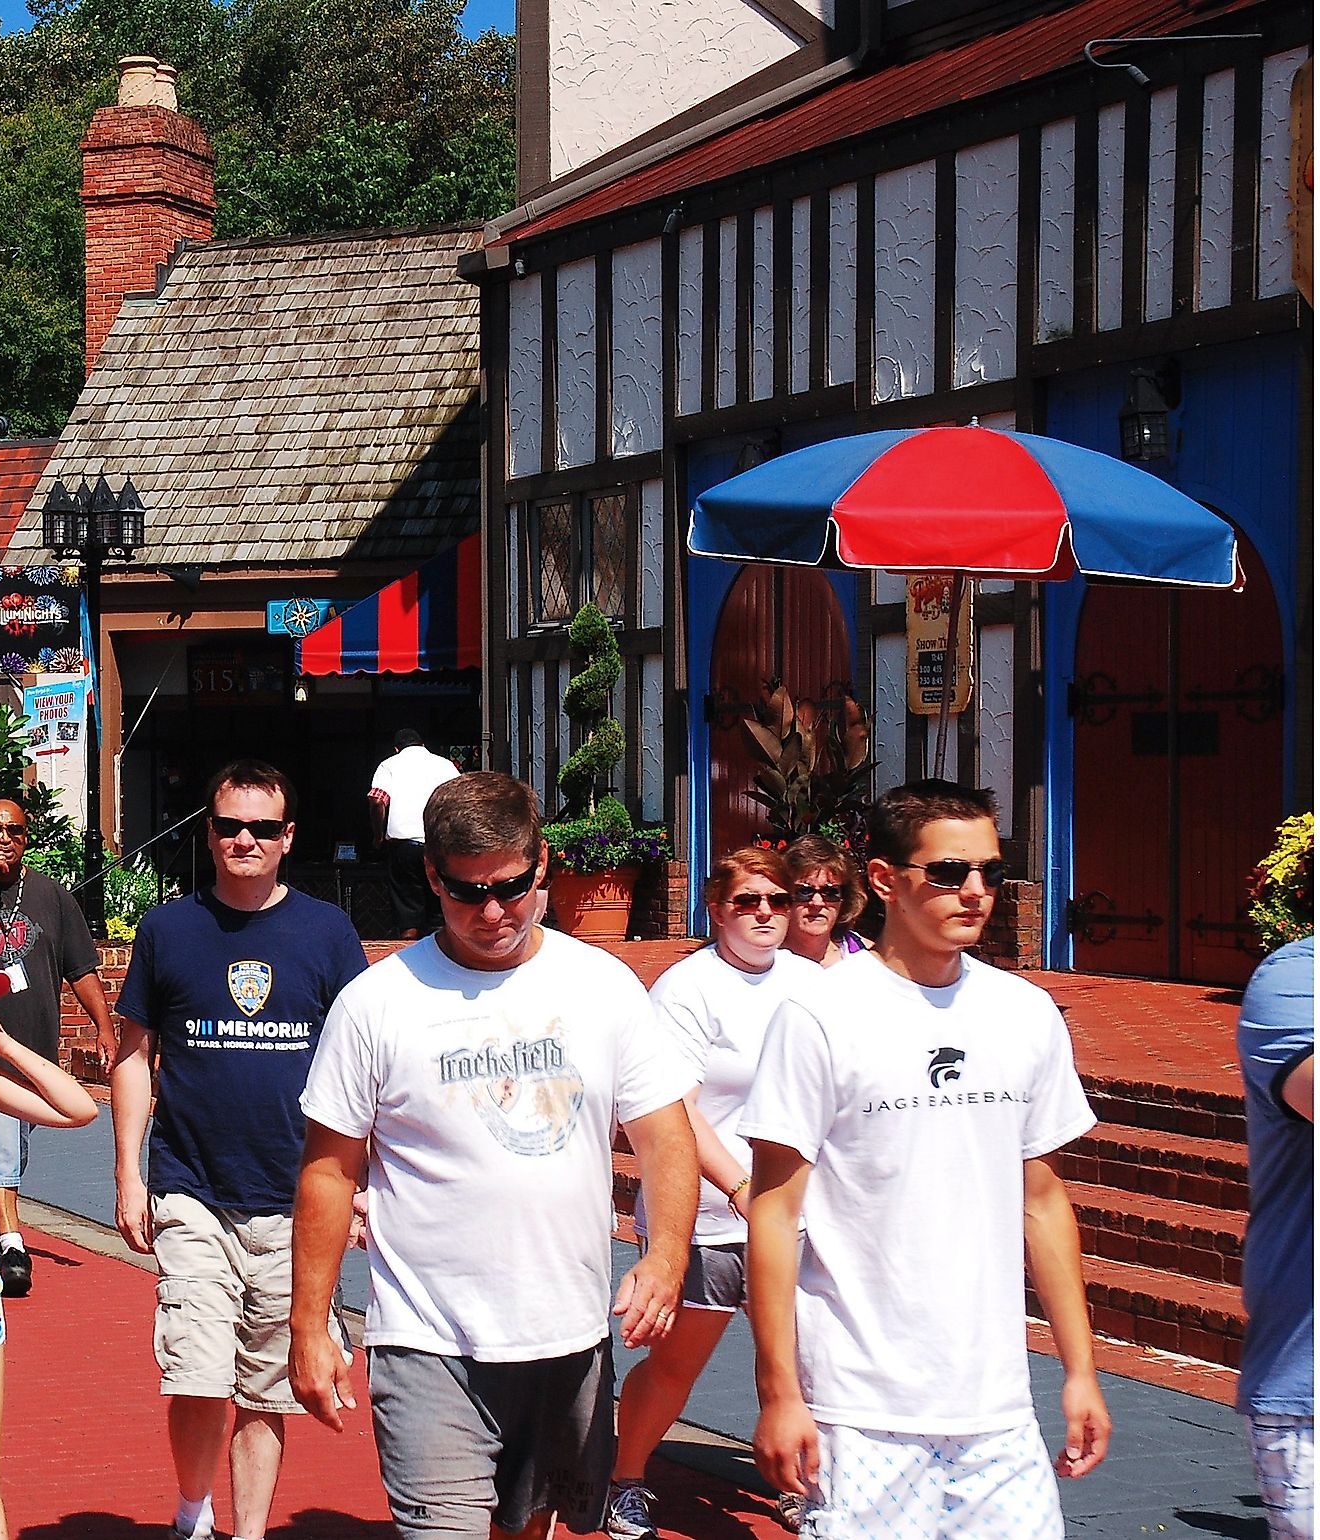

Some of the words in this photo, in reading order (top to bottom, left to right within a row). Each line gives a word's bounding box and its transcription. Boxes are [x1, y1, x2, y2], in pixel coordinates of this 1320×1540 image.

[916, 638, 936, 650] SHOW
[937, 636, 959, 649] TIS
[191, 668, 233, 693] $15
[34, 696, 54, 709] VIEW
[54, 693, 74, 706] YOUR
[39, 707, 68, 720] PHOTOS
[185, 1019, 213, 1036] 9/11
[217, 1020, 311, 1038] MEMORIAL
[223, 1041, 254, 1050] HONOR
[255, 1042, 275, 1050] AND
[863, 1096, 919, 1113] JAGS
